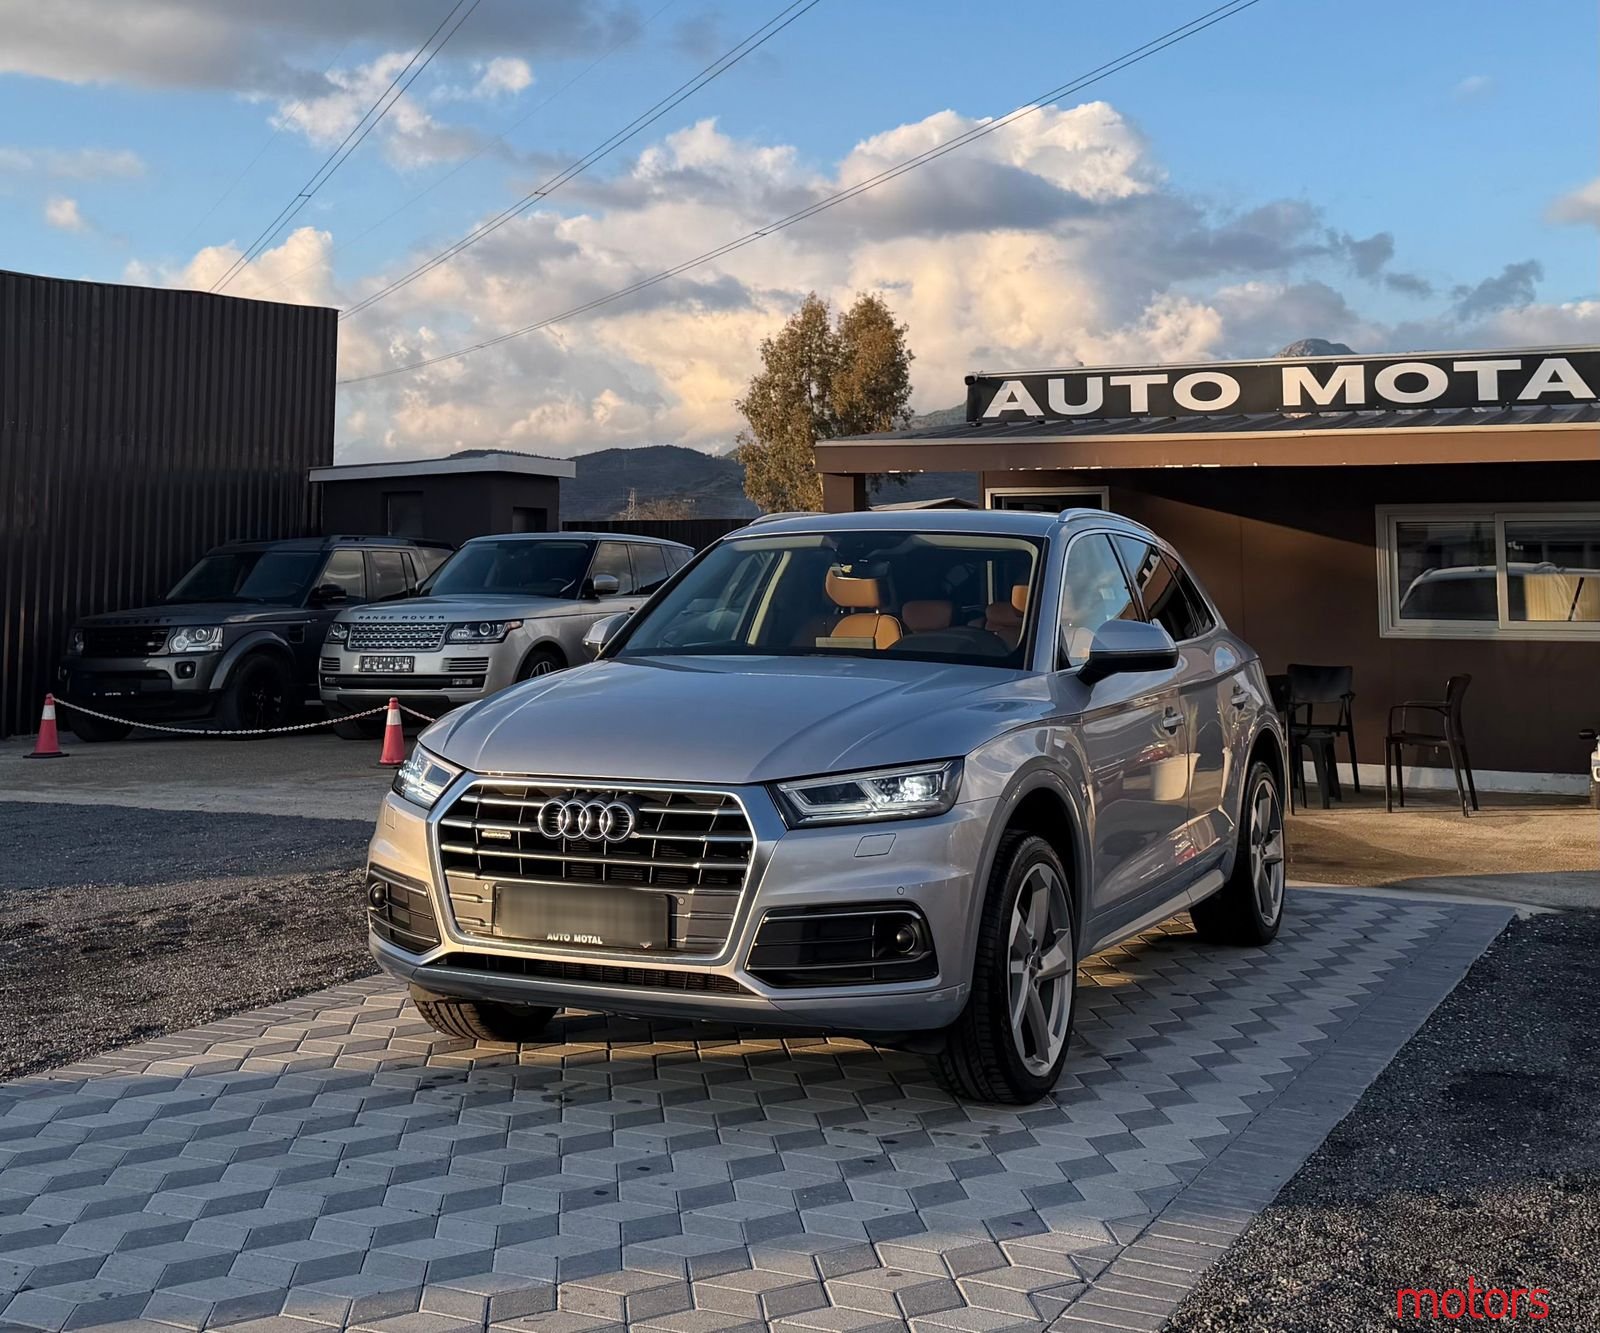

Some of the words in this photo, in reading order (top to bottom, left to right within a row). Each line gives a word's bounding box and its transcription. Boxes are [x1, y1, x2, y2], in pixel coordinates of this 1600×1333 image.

[983, 371, 1241, 417] AUTO
[1282, 358, 1597, 406] MOTA
[546, 933, 571, 942] AUTO
[573, 934, 603, 945] MOTAL
